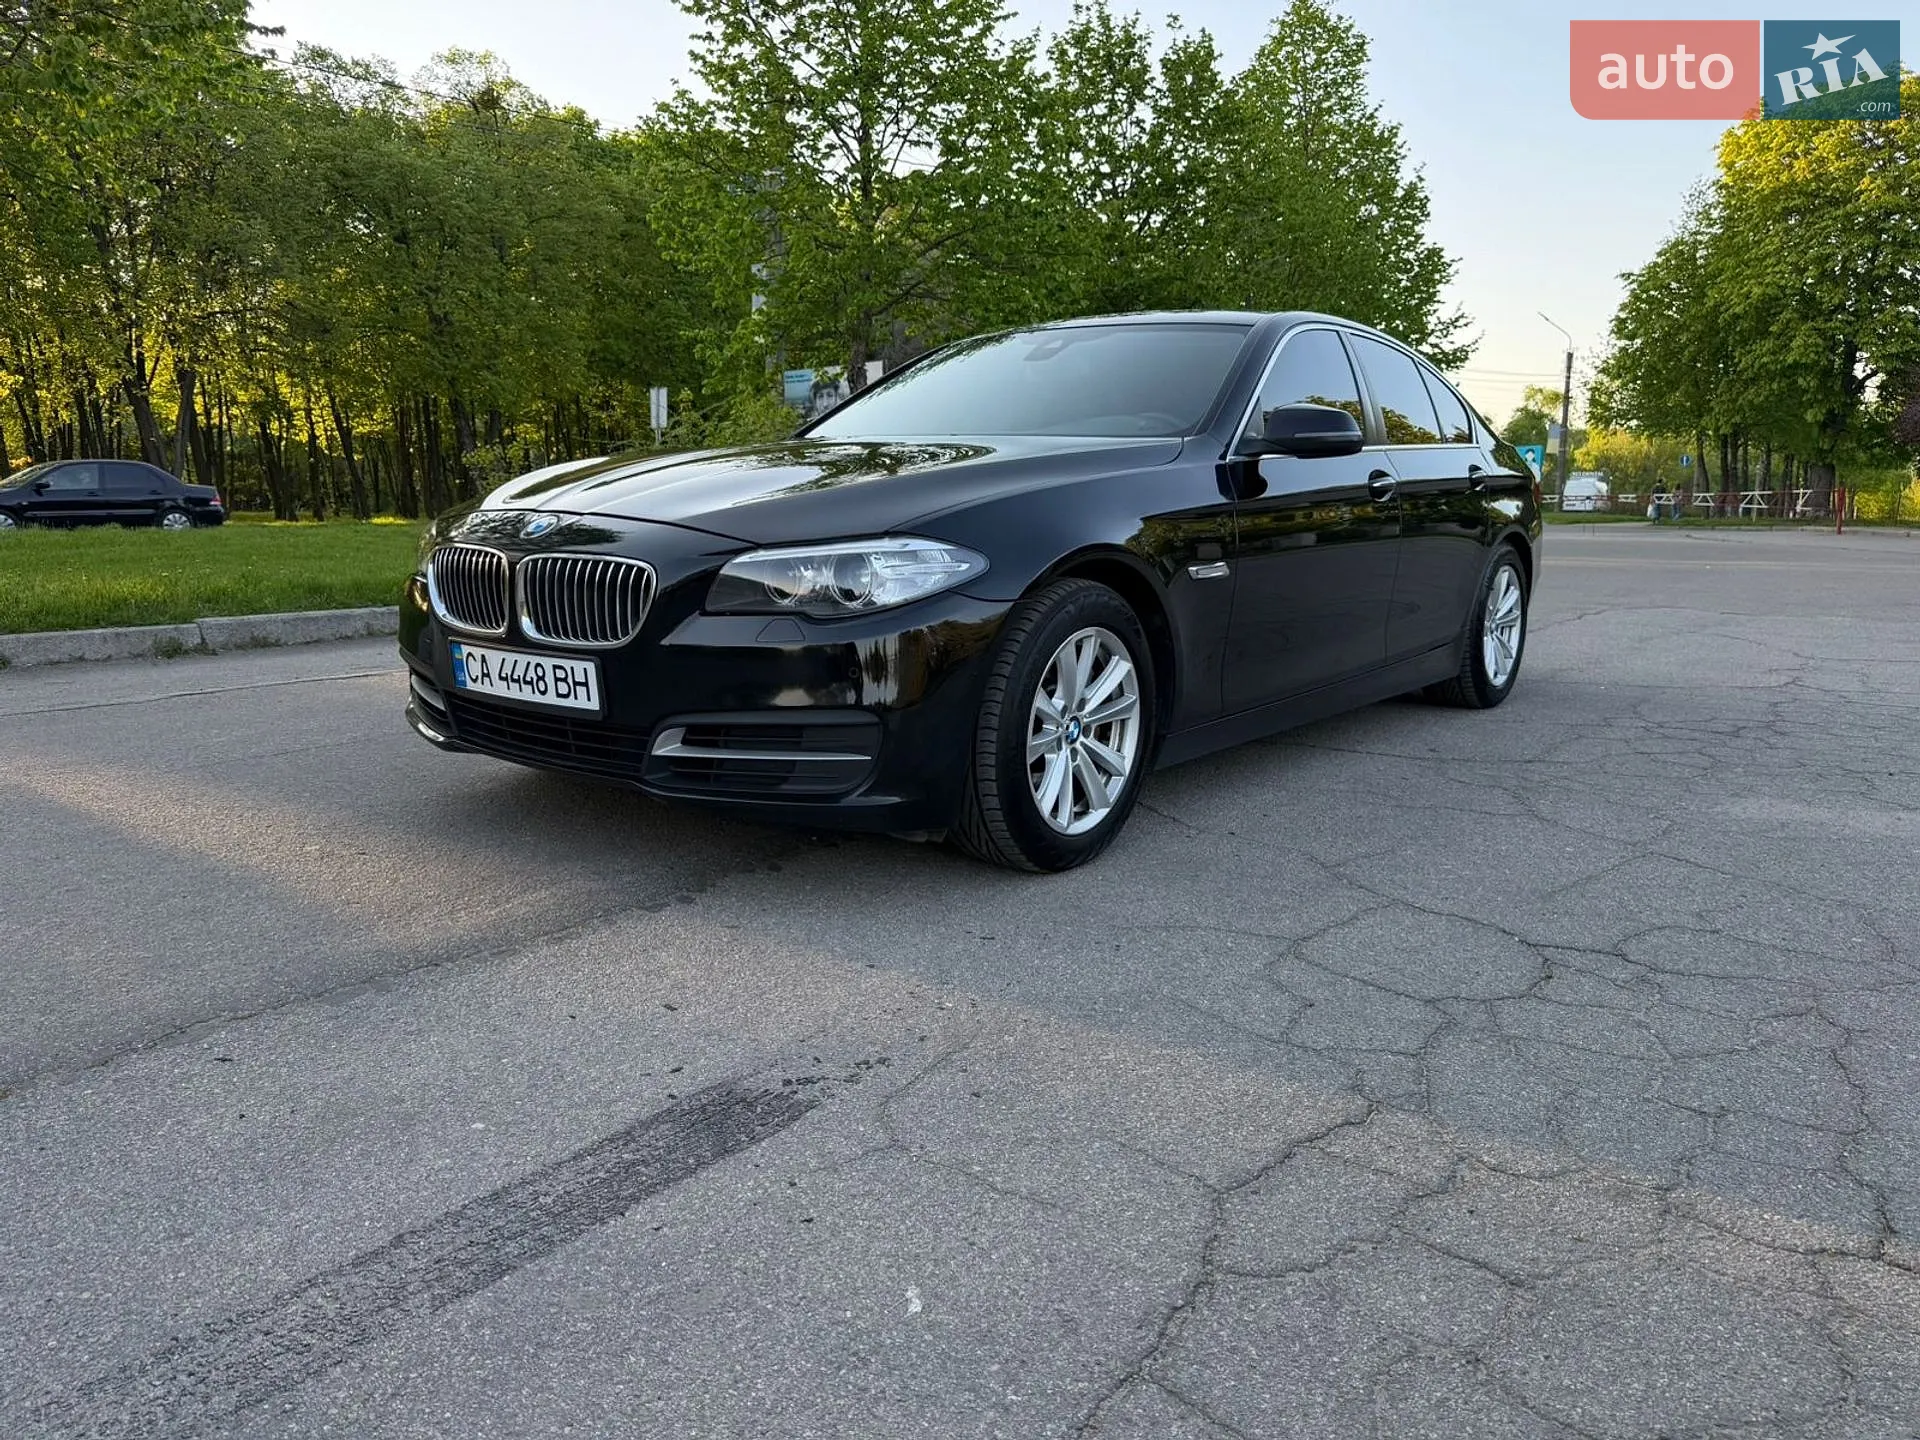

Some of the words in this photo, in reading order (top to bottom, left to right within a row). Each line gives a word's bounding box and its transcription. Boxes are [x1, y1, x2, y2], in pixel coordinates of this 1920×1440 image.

[465, 651, 494, 688] CA
[498, 657, 549, 696] 4448
[552, 664, 592, 702] BH
